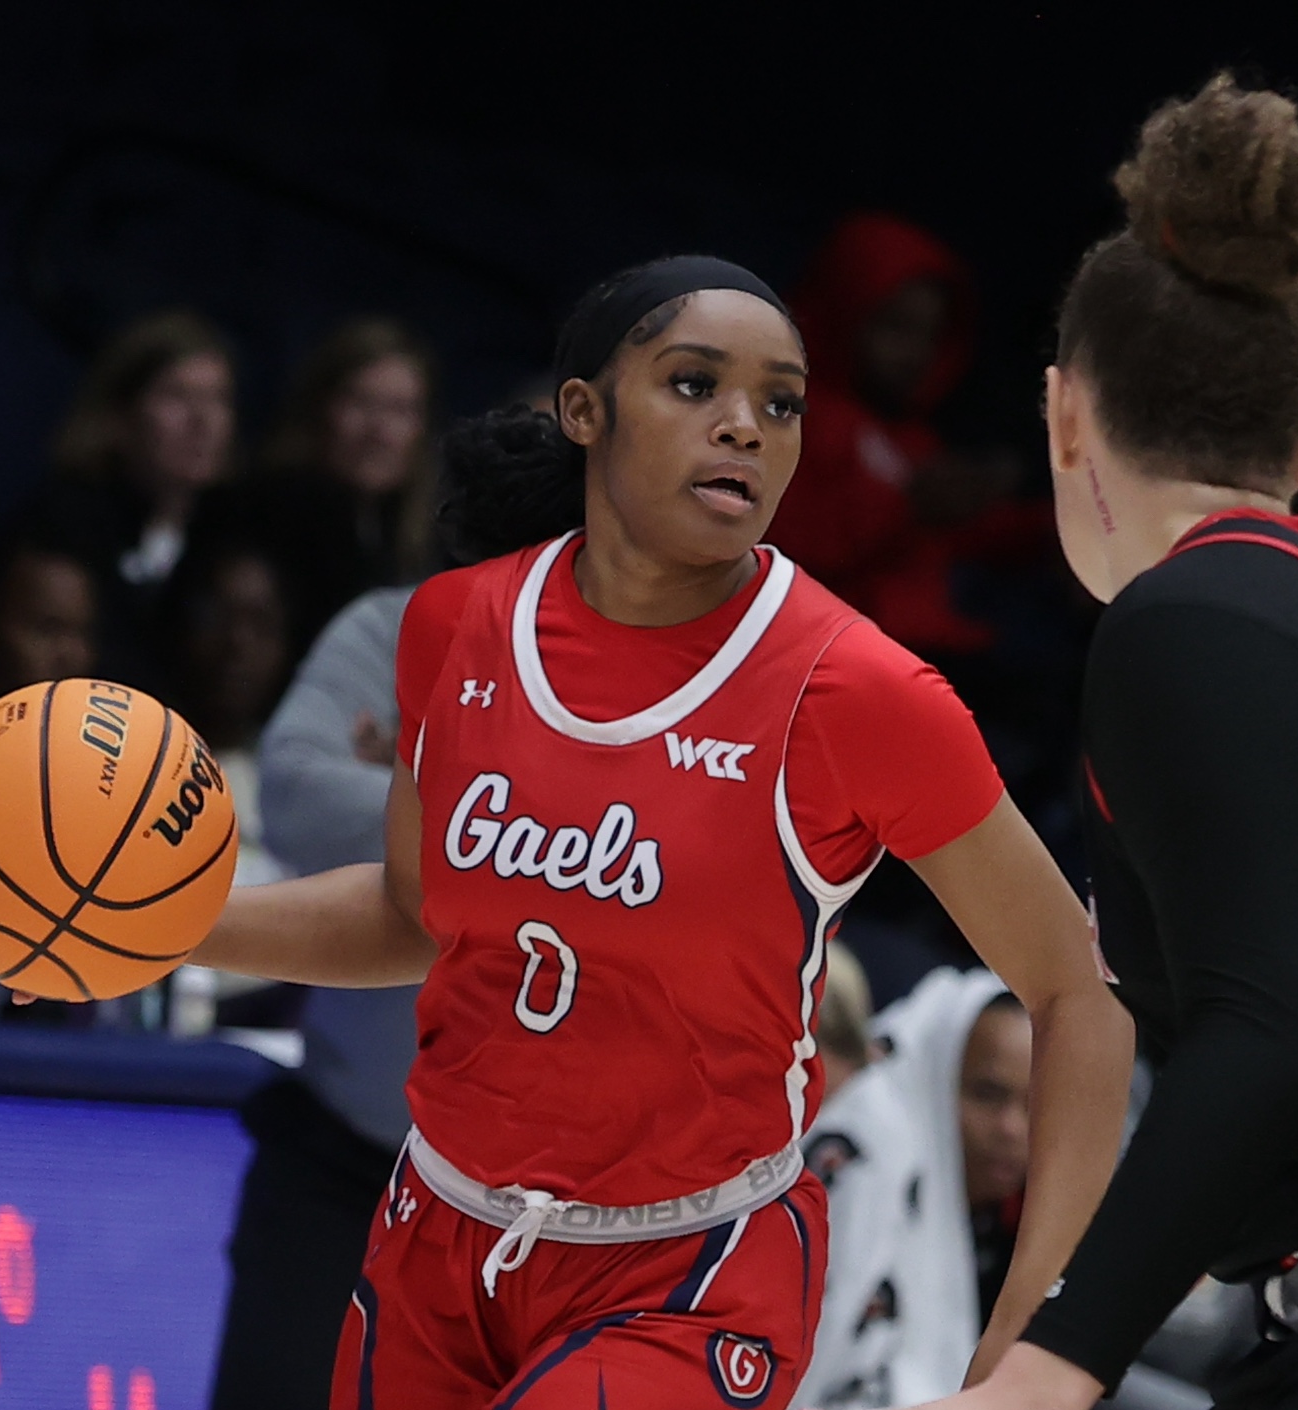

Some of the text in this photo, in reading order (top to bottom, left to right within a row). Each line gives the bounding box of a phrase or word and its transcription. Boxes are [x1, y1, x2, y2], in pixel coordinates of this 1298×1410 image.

[98, 756, 118, 799] NXT
[152, 731, 224, 847] lson
[664, 732, 756, 782] WCC
[444, 772, 663, 908] Gaels
[514, 920, 579, 1034] 0
[728, 1343, 759, 1387] G
